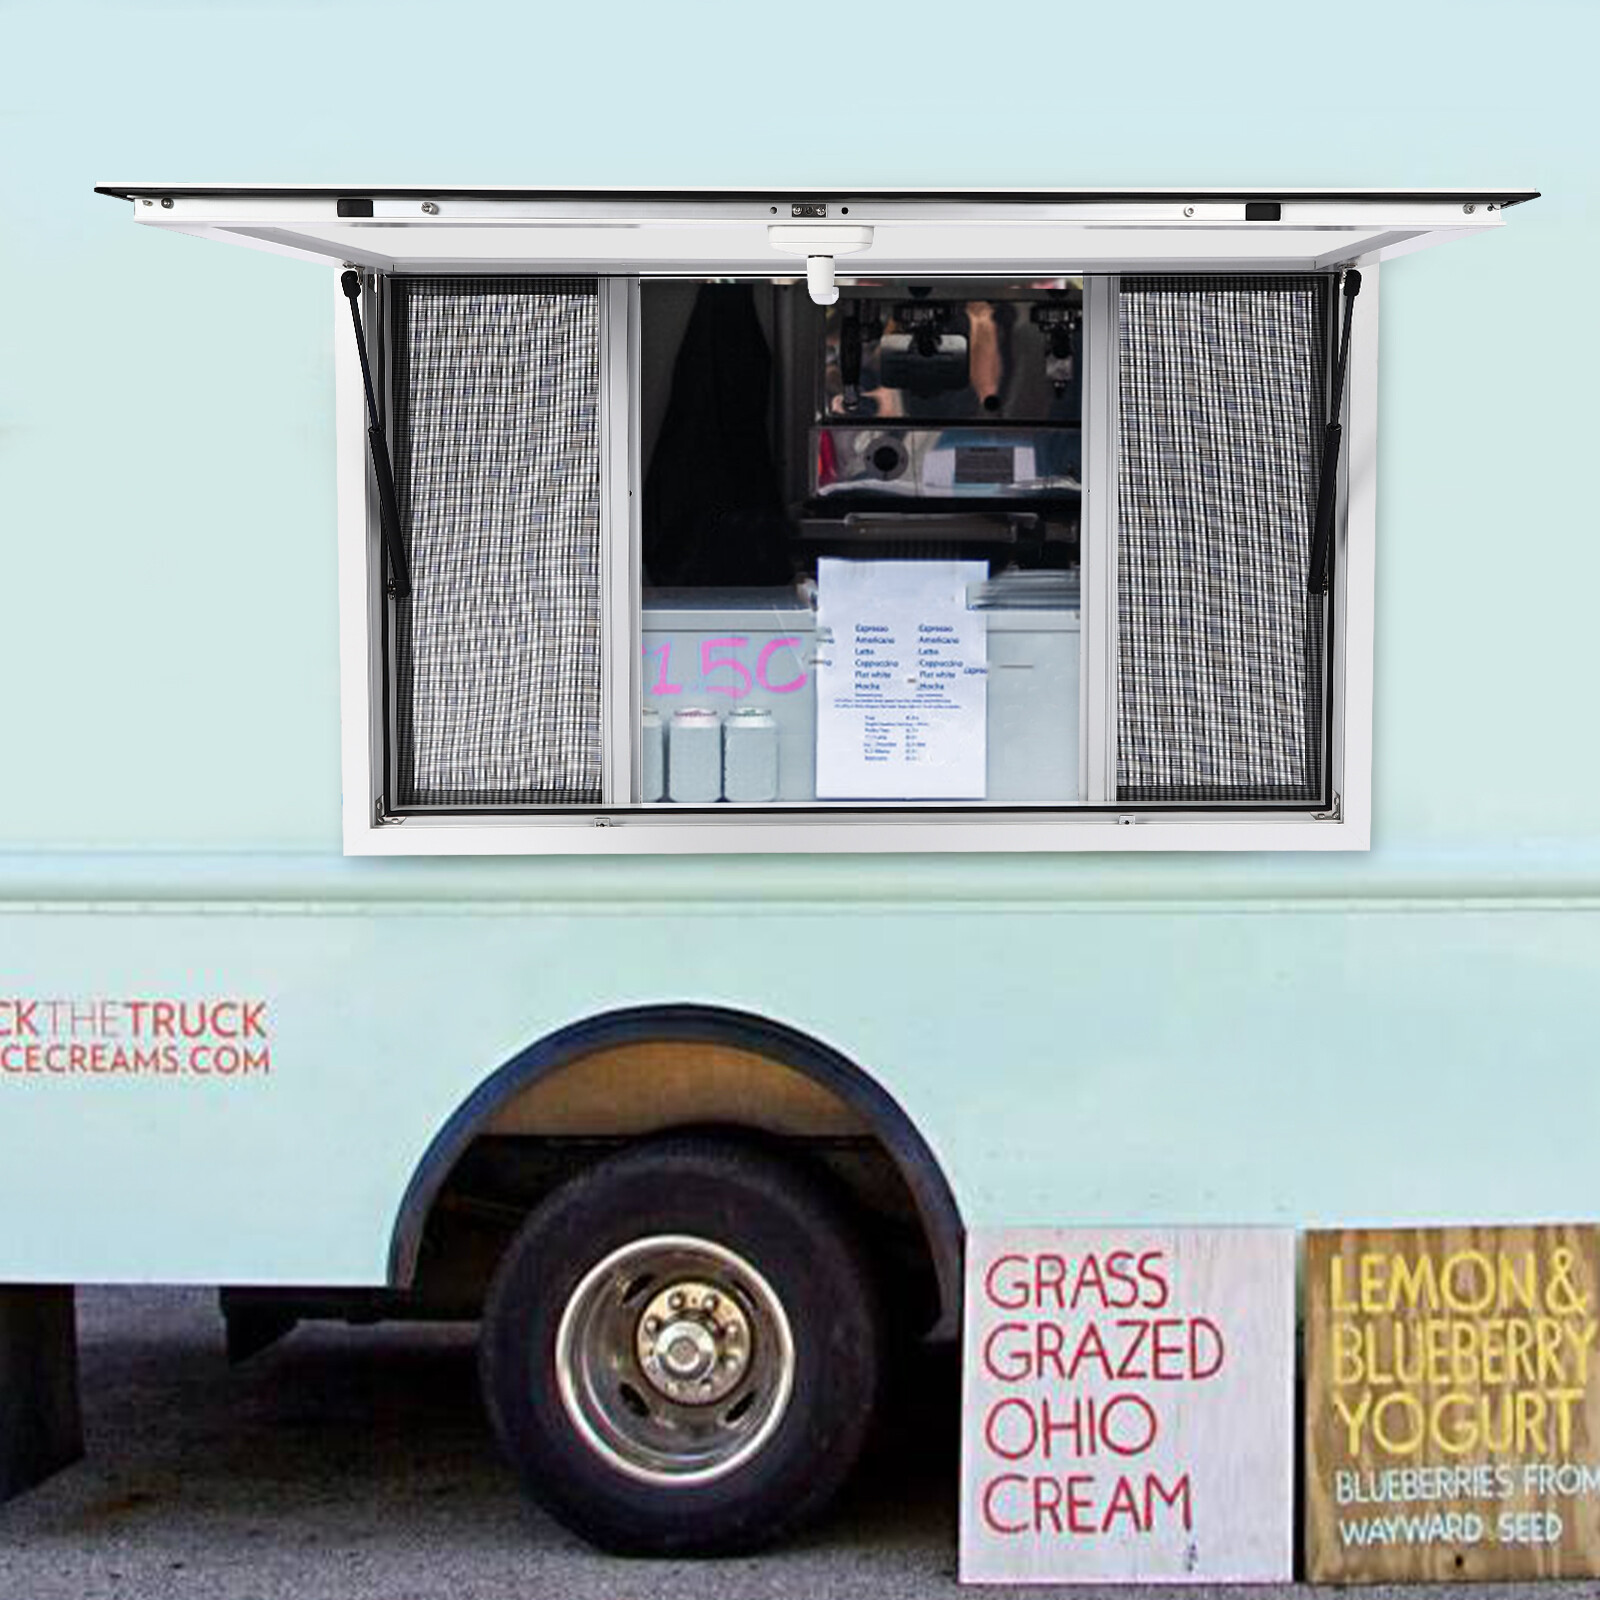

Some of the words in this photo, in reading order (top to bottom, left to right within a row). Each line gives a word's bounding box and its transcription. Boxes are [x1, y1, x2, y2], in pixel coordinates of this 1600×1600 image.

[985, 1251, 1168, 1310] GRASS
[1331, 1250, 1537, 1313] LEMON
[1546, 1248, 1588, 1315] &
[984, 1317, 1225, 1382] GRAZED
[1332, 1318, 1597, 1386] BLUEBERRY
[985, 1393, 1158, 1460] OHIO
[1332, 1388, 1586, 1456] YOGURT
[983, 1472, 1193, 1535] CREAM
[1336, 1466, 1514, 1504] BLUEBERRIES
[1523, 1464, 1600, 1496] FROM
[1340, 1513, 1484, 1546] WAYWARD
[1498, 1512, 1563, 1543] SEED
